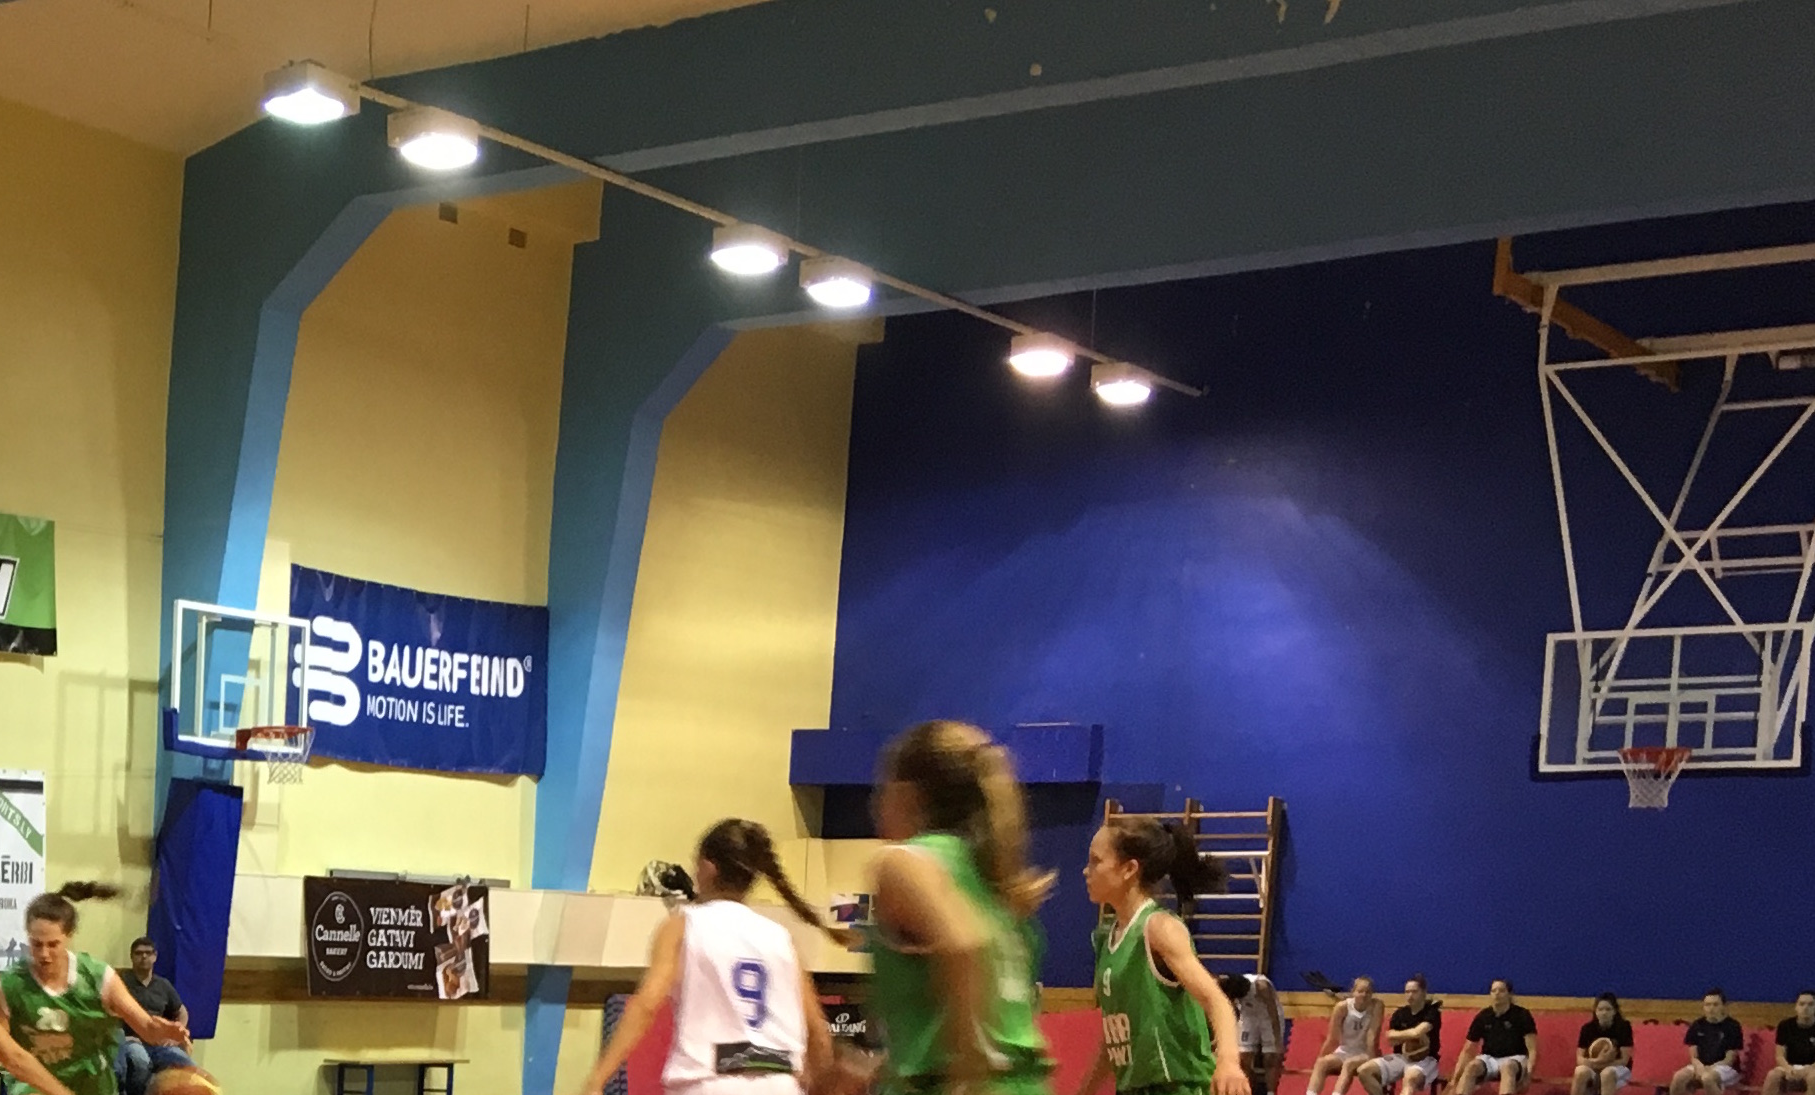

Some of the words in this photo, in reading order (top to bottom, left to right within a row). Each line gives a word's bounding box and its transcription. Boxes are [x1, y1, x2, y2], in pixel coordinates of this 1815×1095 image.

[368, 640, 524, 698] BAUERFEIND
[366, 694, 419, 722] MOTION
[422, 702, 435, 724] IS
[438, 704, 469, 728] LIFE.
[315, 924, 361, 942] Cannelle
[367, 928, 416, 948] GATAVI
[366, 950, 426, 970] GARDUMI
[732, 957, 768, 1031] 9
[826, 1020, 867, 1033] ALDING
